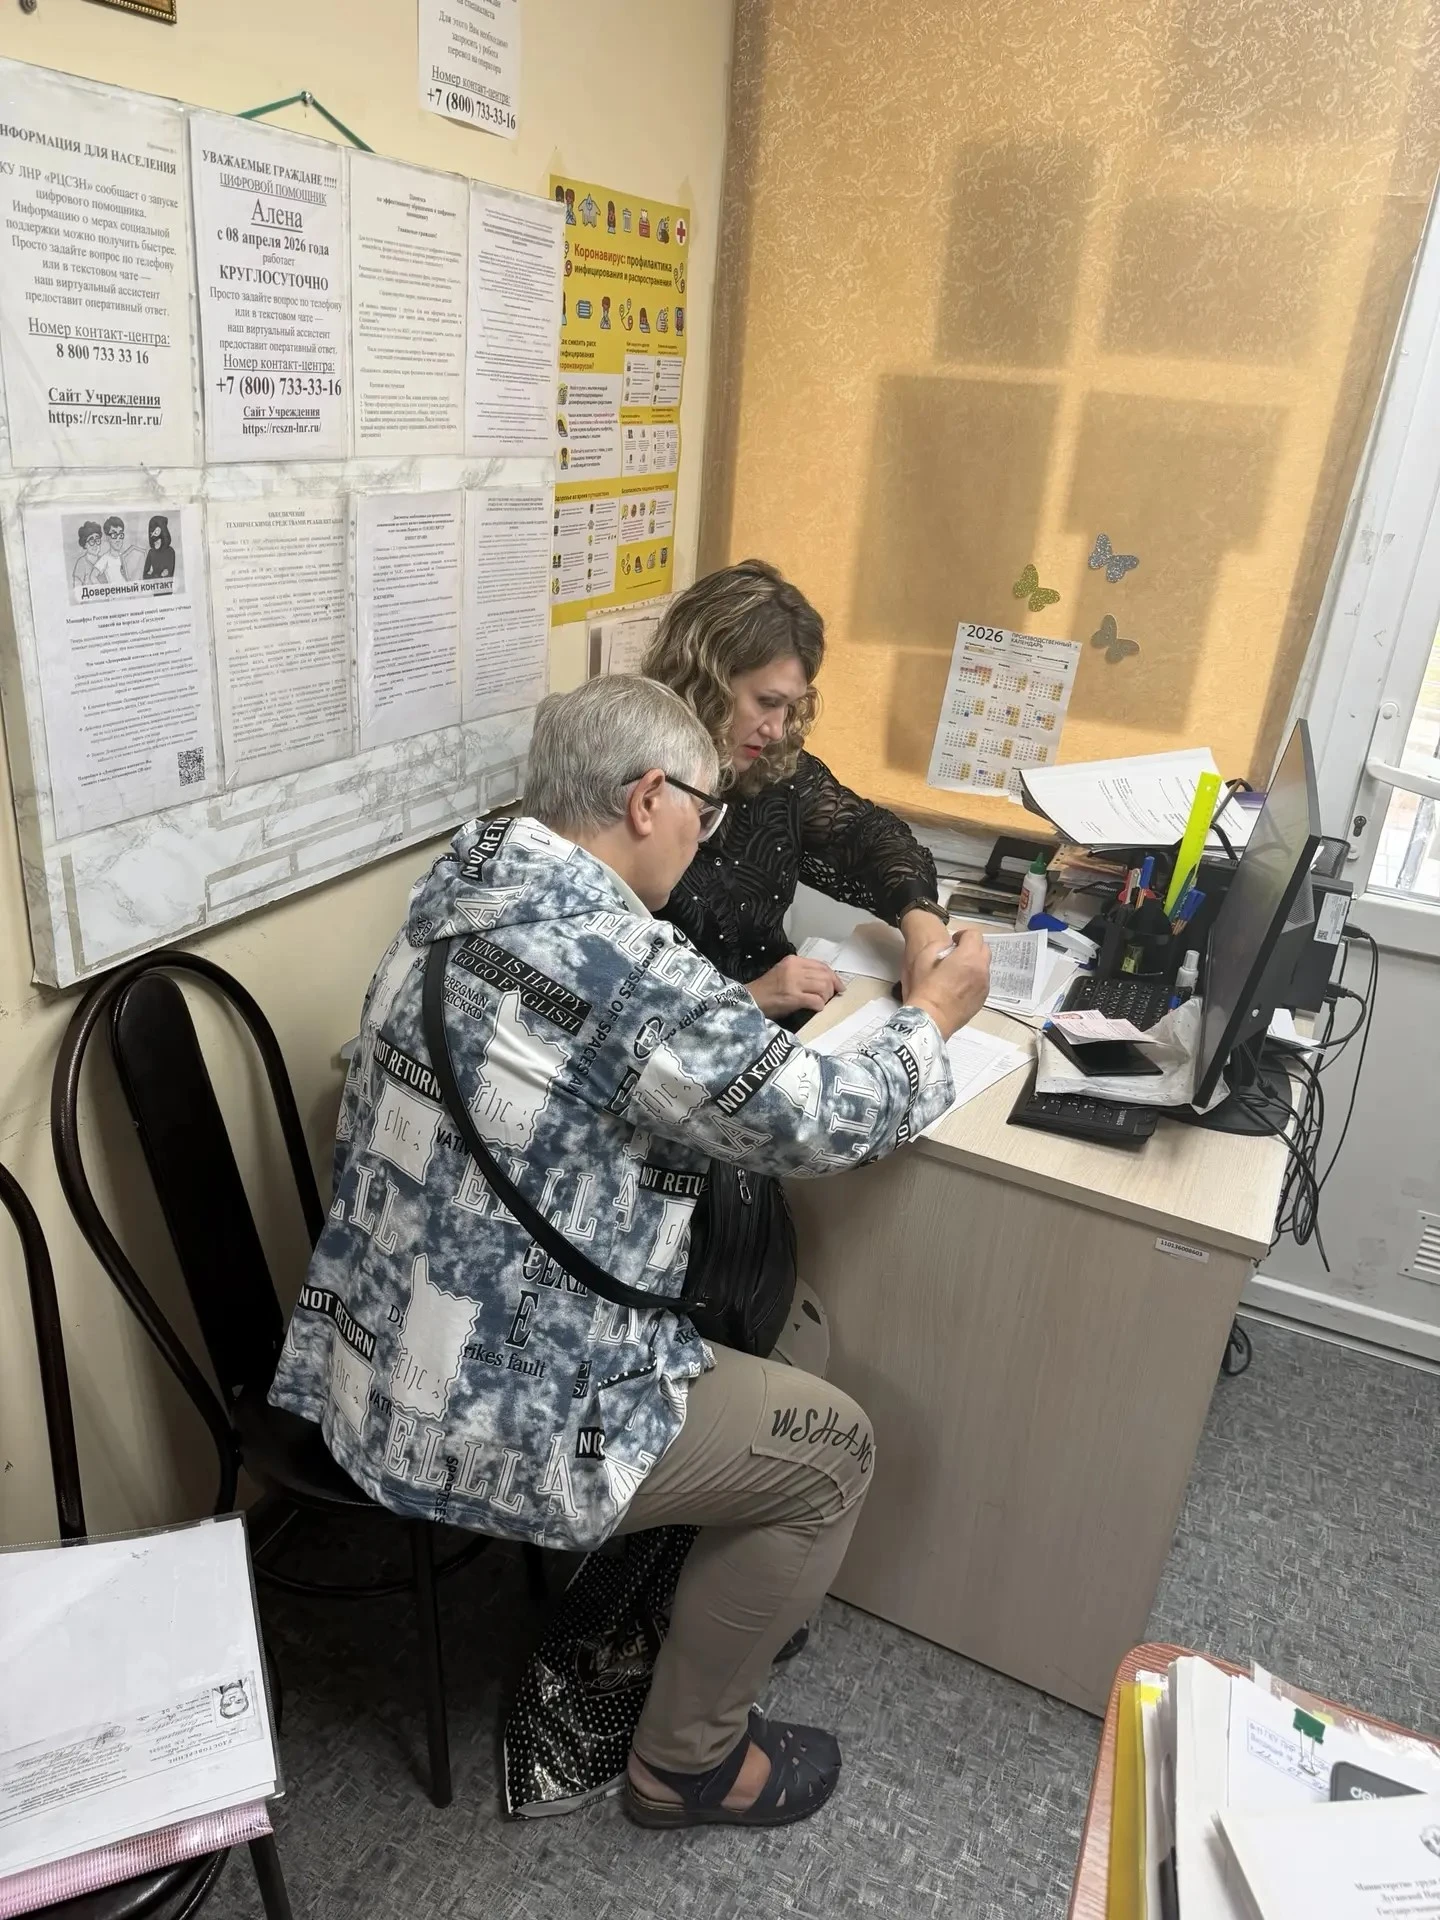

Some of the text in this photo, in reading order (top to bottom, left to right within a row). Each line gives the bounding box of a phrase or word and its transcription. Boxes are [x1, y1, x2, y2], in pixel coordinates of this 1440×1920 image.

[432, 65, 510, 104] Номер контакт-центра:
[427, 87, 516, 129] +7 (800) 733-33-16
[0, 123, 176, 175] НФОРМАЦИЯ ДЛЯ НАСЕЛЕНИЯ
[202, 149, 271, 175] УВАЖАЕМЫЕ
[273, 165, 322, 186] ГРАЖДАНЕ
[0, 161, 15, 174] КУ
[19, 165, 42, 180] ЛНР
[45, 172, 93, 191] «РЦСЗН»
[95, 183, 138, 200] сообщает
[150, 195, 178, 208] запуске
[220, 173, 327, 205] ЦИФРОВОЙ ПОМОЩНИК
[36, 189, 147, 218] цифрового помощника.
[251, 198, 303, 229] Алена
[12, 200, 80, 223] Информацию
[92, 216, 118, 231] мерах
[121, 222, 170, 238] социальной
[6, 218, 177, 255] поддержки можно получить быстрее.
[226, 226, 239, 242] 08
[242, 233, 281, 249] апреля
[284, 236, 306, 252] 2026
[309, 244, 329, 256] года
[12, 235, 174, 273] Просто задайте вопрос по телефону
[263, 253, 295, 266] работает
[574, 243, 672, 272] Коронавирус: профилактика
[43, 259, 60, 271] или
[71, 264, 117, 278] текстовом
[120, 271, 138, 281] чате
[220, 264, 329, 291] КРУГЛОСУТОЧНО
[575, 265, 623, 281] инфицирования
[629, 274, 672, 288] распространения
[34, 275, 160, 299] наш виртуальный ассистент
[210, 286, 240, 300] Просто
[242, 292, 272, 304] задайте
[274, 295, 298, 307] вопрос
[311, 301, 342, 312] телефону
[25, 291, 170, 316] предоставит оперативный ответ.
[235, 309, 250, 317] или
[259, 311, 296, 322] текстовом
[298, 315, 313, 323] чате
[28, 317, 170, 347] Номер контакт-центра:
[228, 324, 330, 339] наш виртуальный ассистент
[56, 343, 149, 365] 8 800 733 33 16
[220, 340, 337, 354] предоставит оперативный ответ.
[224, 353, 335, 374] Номер контакт-центра:
[49, 387, 161, 407] Сайт Учреждения
[216, 376, 342, 399] +7 (800) 733-33-16
[49, 409, 163, 427] https://rcszn-lnr.ru/
[243, 406, 320, 419] Сайт Учреждения
[242, 422, 322, 436] https://rcszn-lnr.ru/
[81, 580, 174, 599] Доверенный контакт
[967, 625, 1004, 643] 2026
[1010, 639, 1043, 648] КАЛЕНДАРЬ
[1011, 632, 1072, 648] ПРОИЗВОДСТВЕННЫЙ
[468, 938, 586, 1013] KING IS HAPPY
[454, 952, 582, 1032] GO GO ENGLISH
[607, 999, 624, 1022] OF
[576, 1020, 612, 1080] SPACES
[375, 1038, 442, 1100] NOT RETURN
[716, 1075, 755, 1114] NOT
[640, 1166, 661, 1187] NOT
[299, 1288, 375, 1357] NOT RETURN
[506, 1352, 547, 1379] fault
